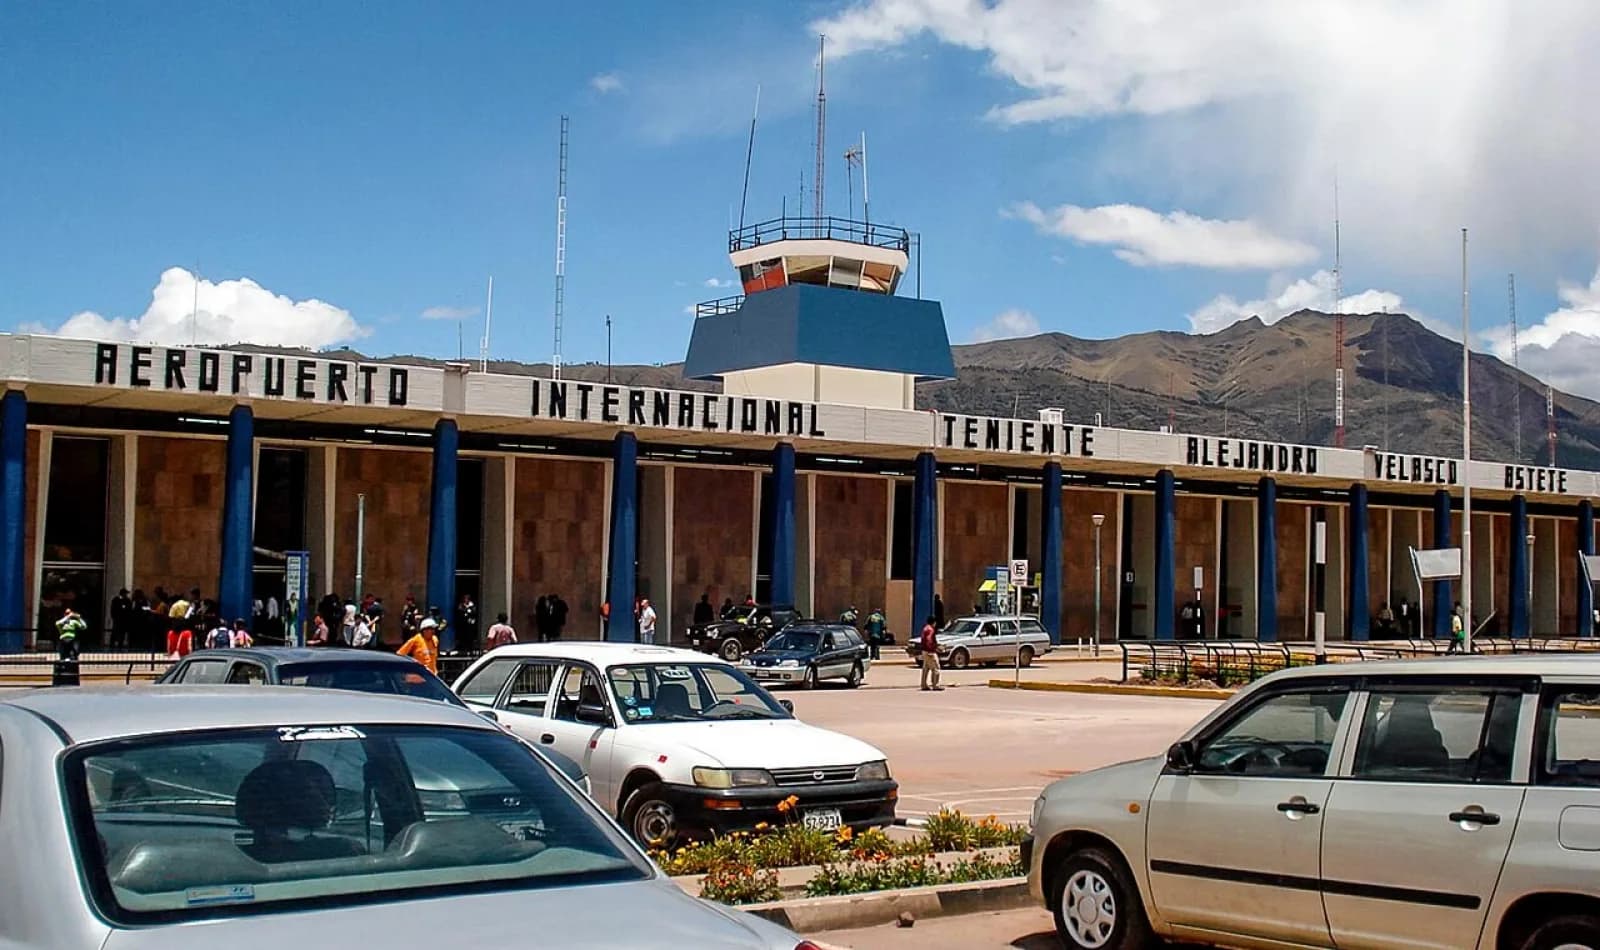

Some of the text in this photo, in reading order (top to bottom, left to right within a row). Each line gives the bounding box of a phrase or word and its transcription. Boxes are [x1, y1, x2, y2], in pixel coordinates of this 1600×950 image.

[95, 342, 1567, 494] AEROPUERTO INTERNACIONAL TENIENTE ALEJANDRO VELASCO ASTETE
